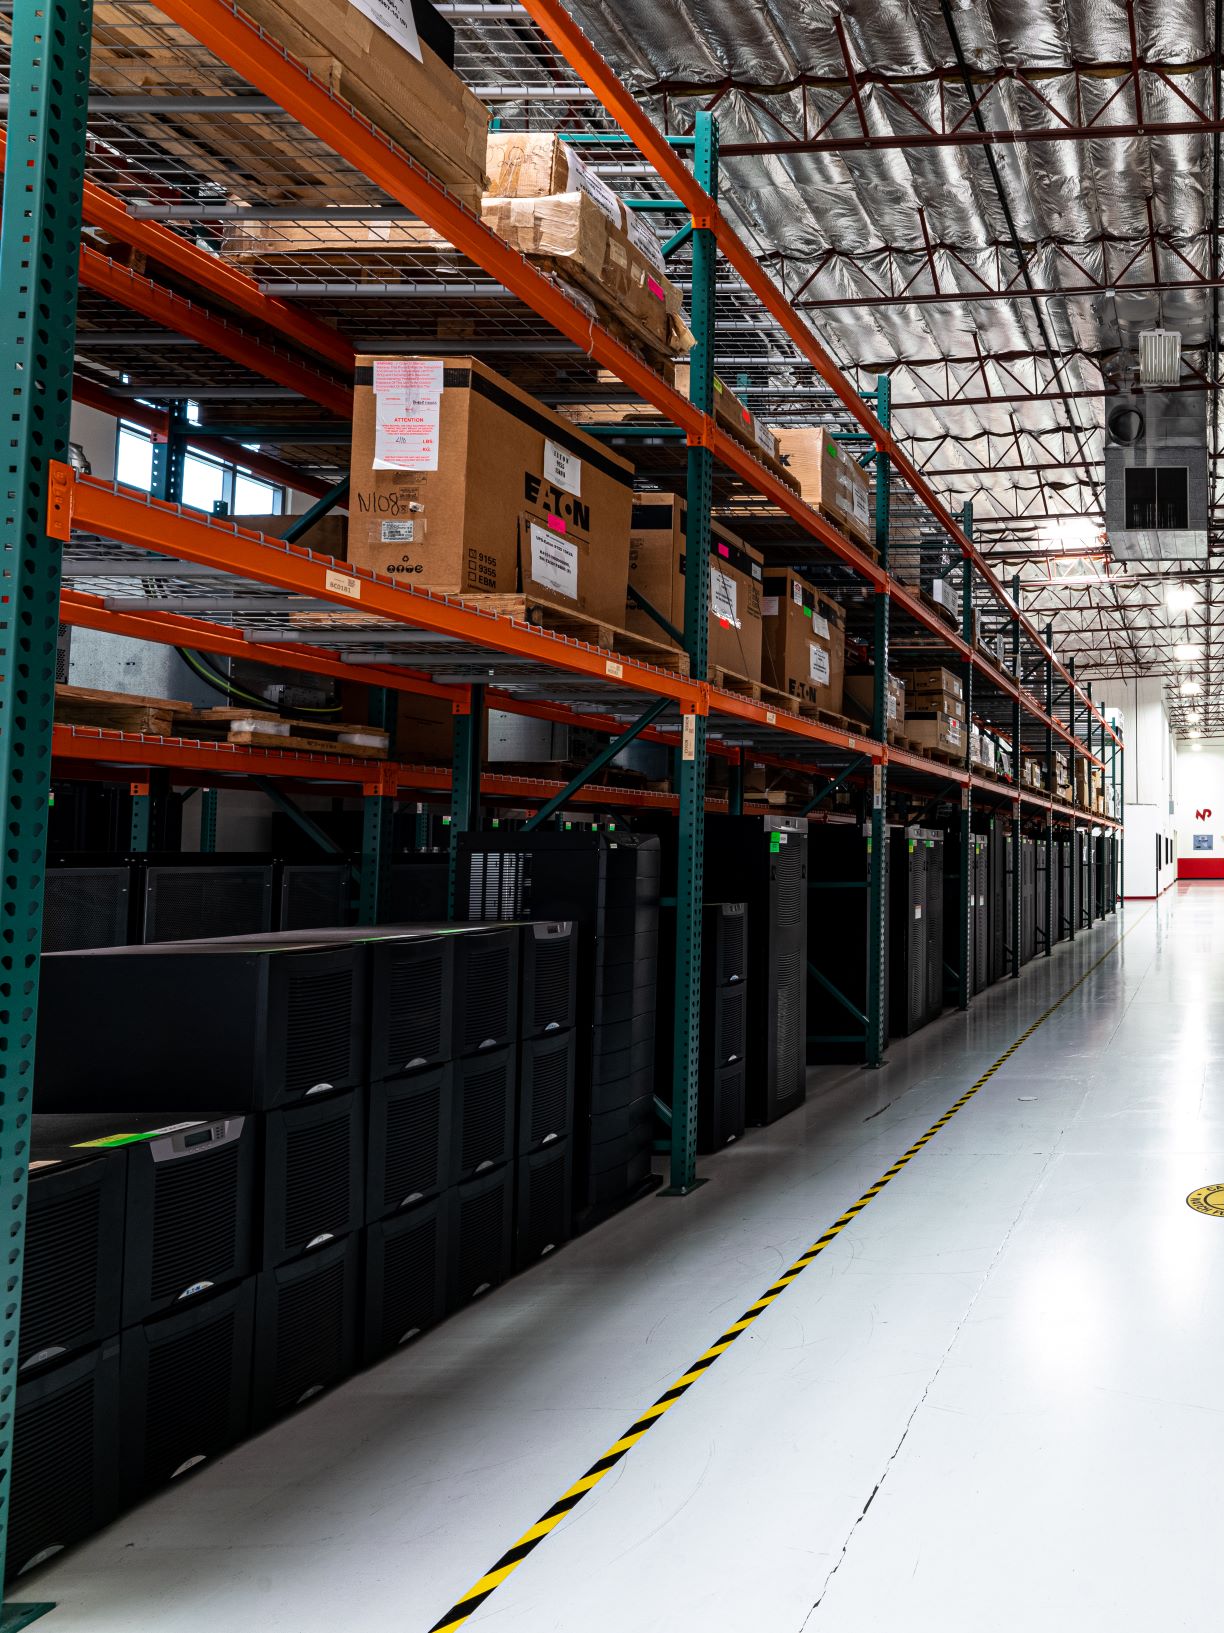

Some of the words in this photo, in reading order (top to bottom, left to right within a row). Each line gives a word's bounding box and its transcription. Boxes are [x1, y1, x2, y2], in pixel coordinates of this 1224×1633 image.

[525, 471, 590, 532] EATON
[478, 552, 497, 567] 9155
[478, 564, 497, 578] 9355
[478, 576, 497, 589] EBM
[788, 677, 817, 704] EATON
[1190, 1197, 1213, 1213] WATCH
